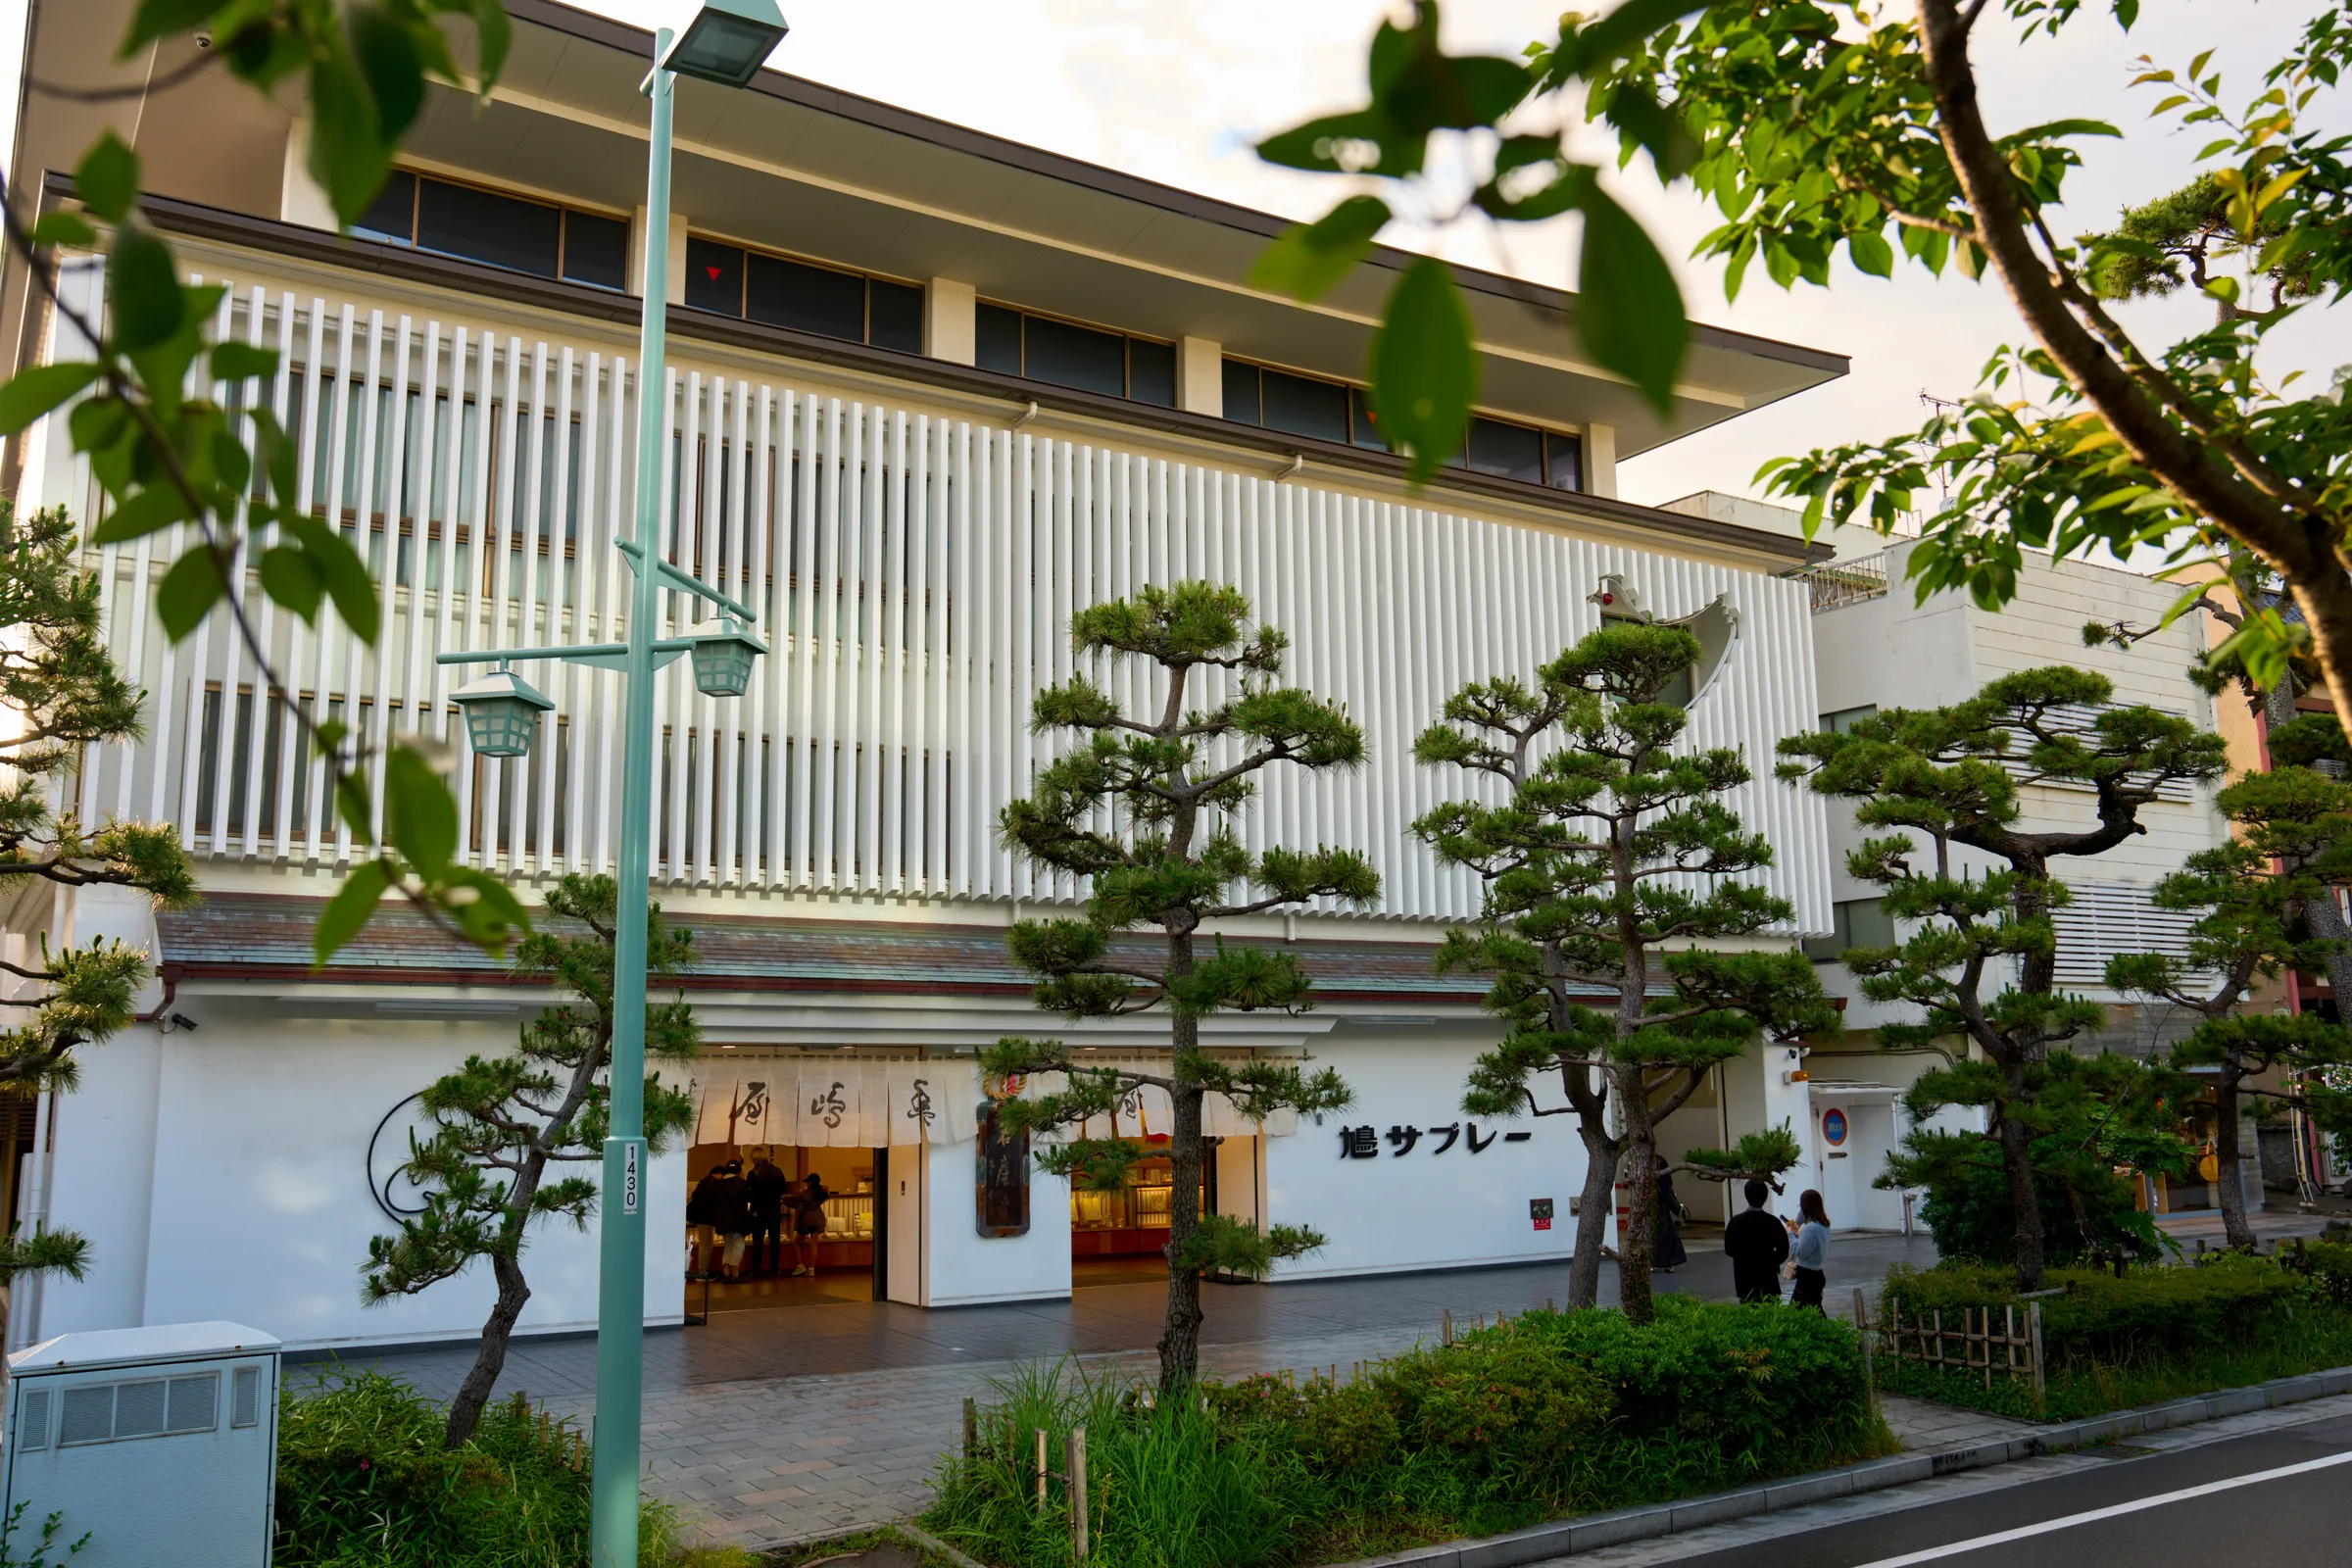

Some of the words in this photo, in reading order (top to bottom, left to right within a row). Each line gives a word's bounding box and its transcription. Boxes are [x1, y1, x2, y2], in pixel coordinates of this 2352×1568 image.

[1339, 1121, 1532, 1158] 鳩サブレー
[626, 1145, 636, 1206] 1430
